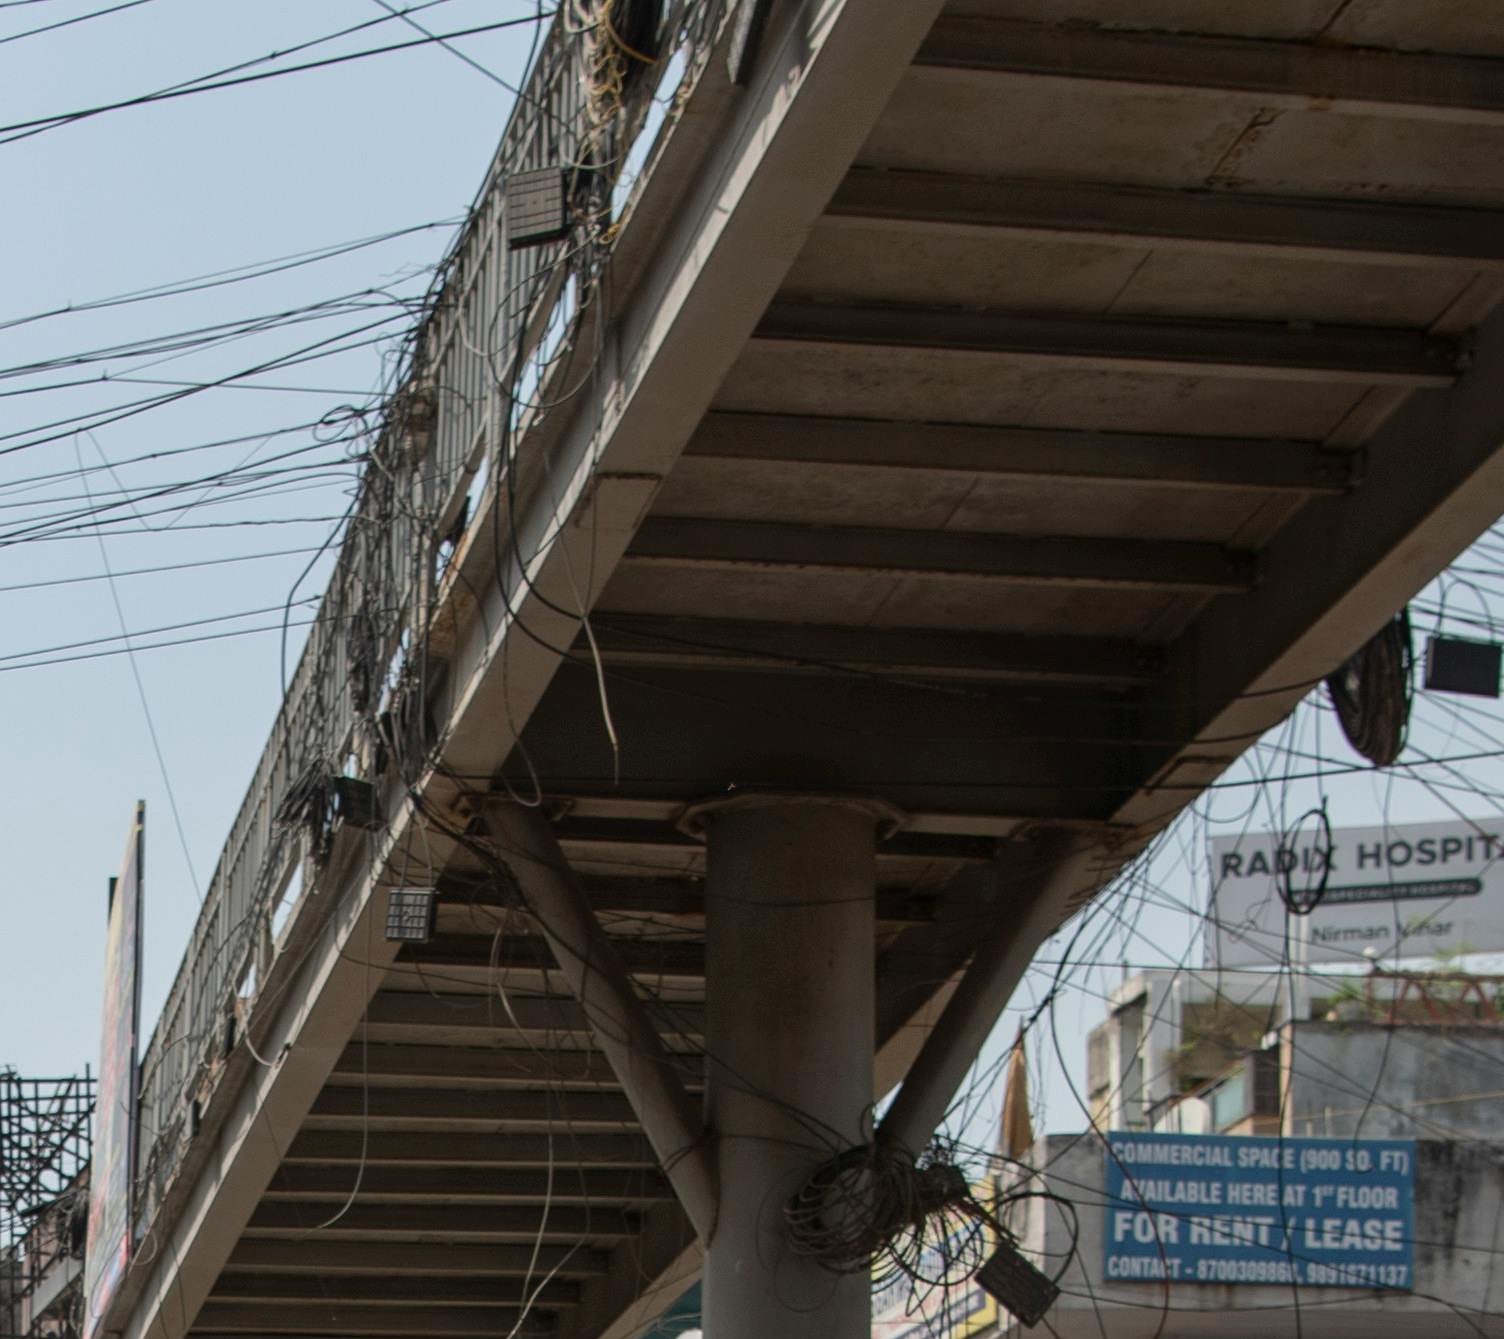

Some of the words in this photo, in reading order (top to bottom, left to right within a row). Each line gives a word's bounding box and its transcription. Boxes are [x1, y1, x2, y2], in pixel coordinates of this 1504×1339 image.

[1221, 845, 1338, 878] RADIX
[1311, 926, 1389, 943] Nirman
[1112, 1142, 1232, 1167] COMMERCIAL
[1238, 1145, 1295, 1169] SPACE
[1300, 1148, 1341, 1174] (900
[1380, 1151, 1410, 1176] FT)
[1119, 1180, 1222, 1205] AVAILABLE
[1228, 1183, 1277, 1206] HERE
[1283, 1185, 1306, 1207] AT
[1337, 1186, 1399, 1209] FLOOR
[1114, 1211, 1179, 1244] FOR
[1189, 1215, 1276, 1247] RENT
[1281, 1217, 1296, 1250] /
[1305, 1217, 1403, 1251] LEASE
[1108, 1256, 1181, 1278] CONTACT
